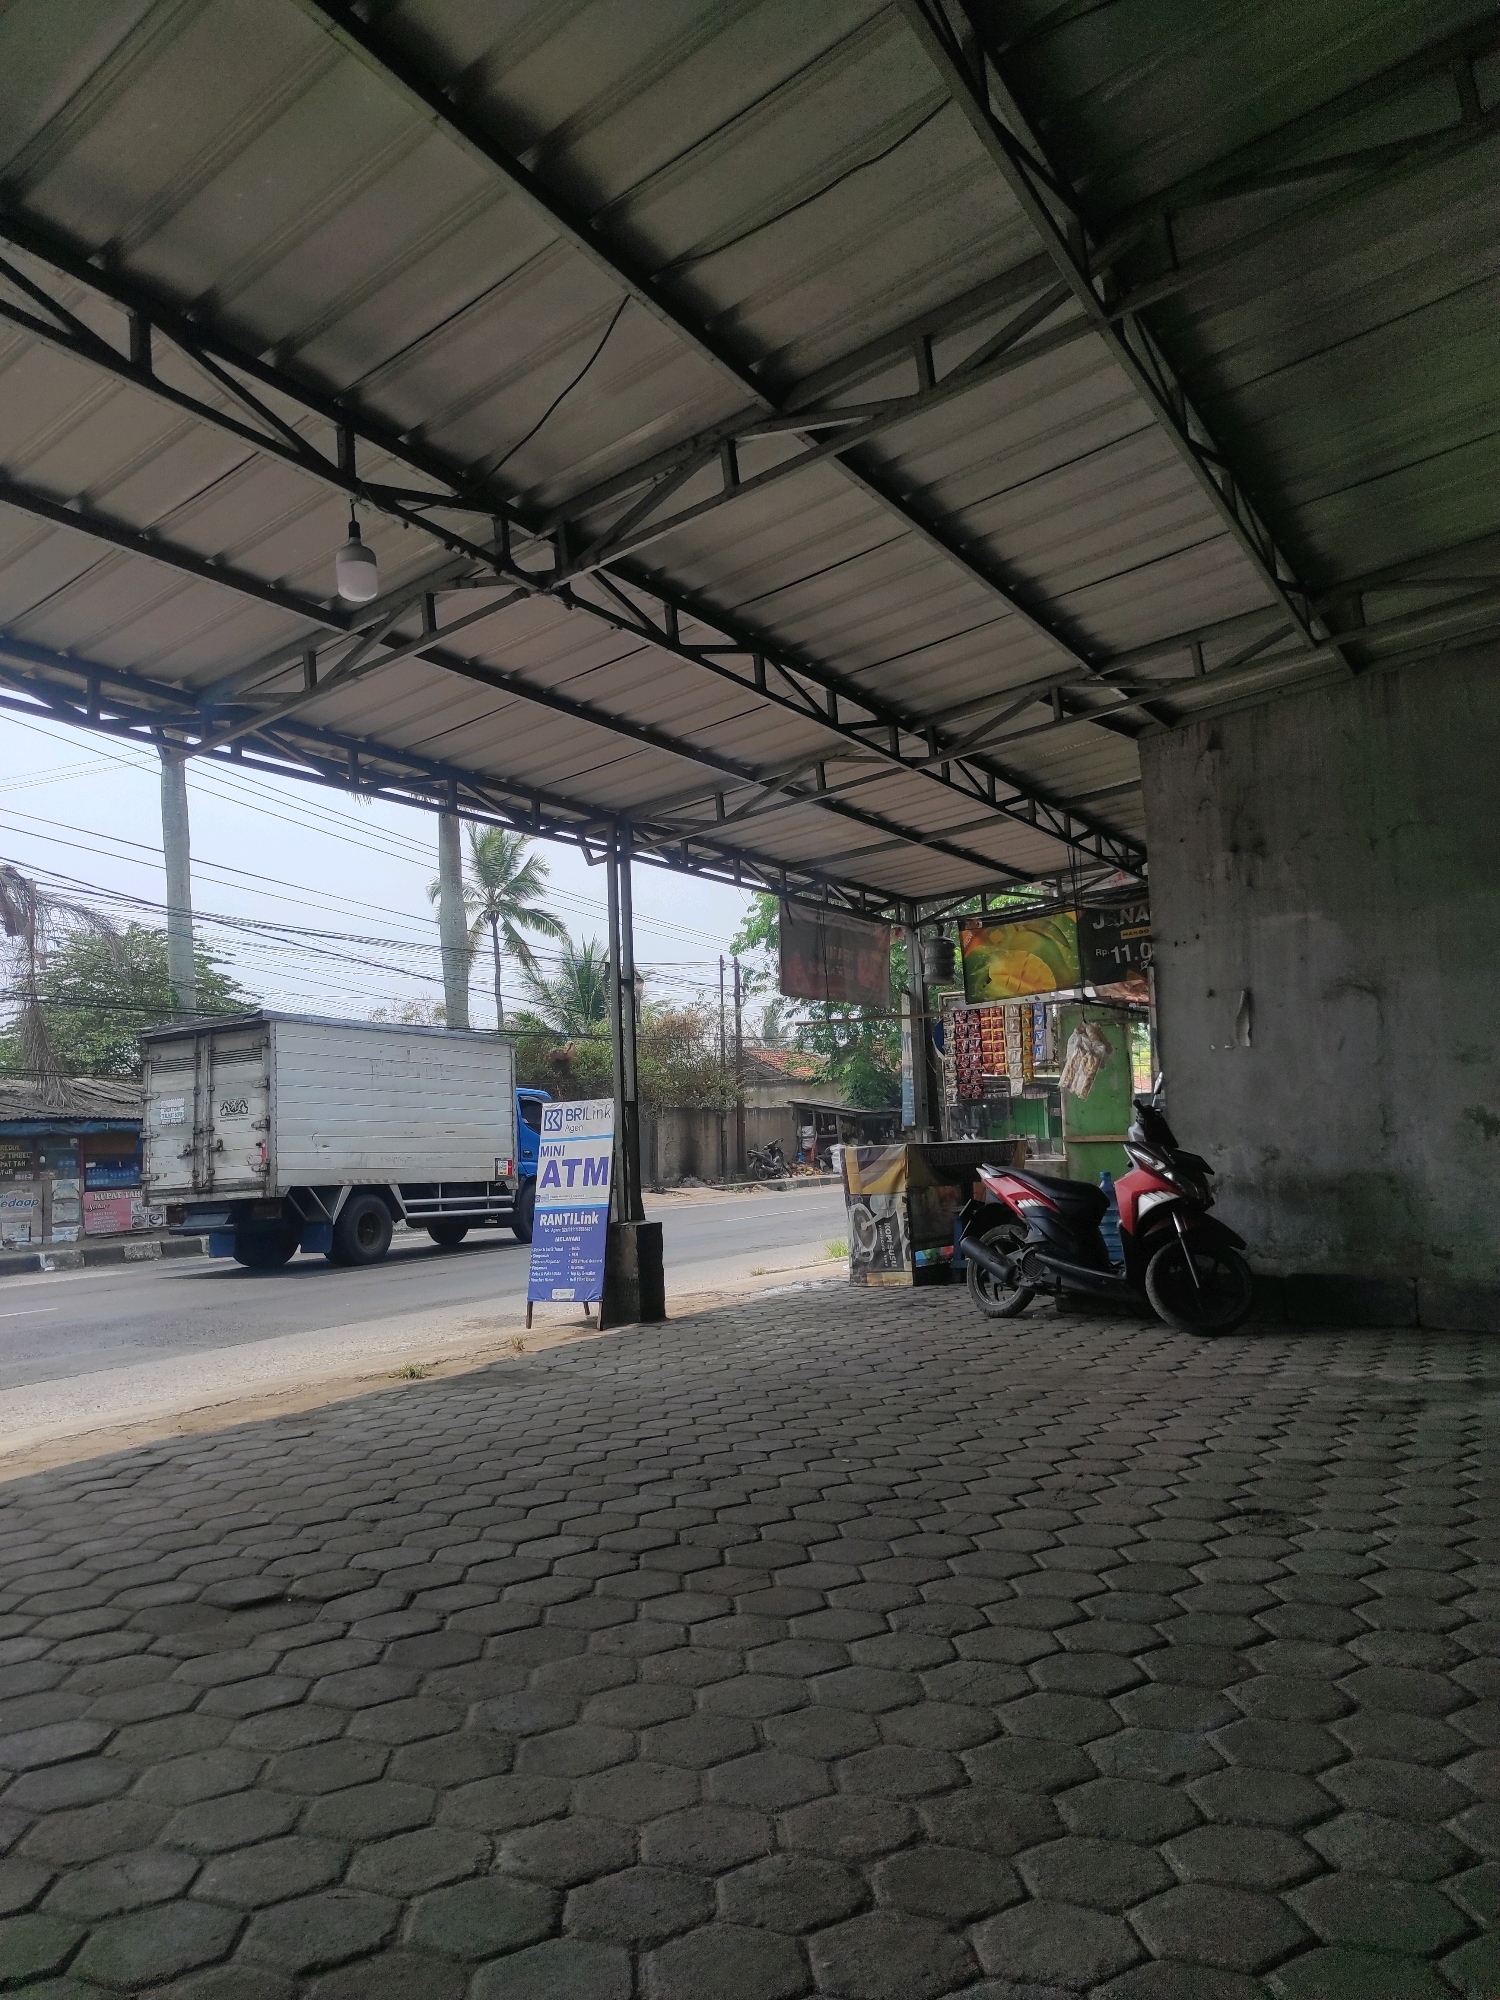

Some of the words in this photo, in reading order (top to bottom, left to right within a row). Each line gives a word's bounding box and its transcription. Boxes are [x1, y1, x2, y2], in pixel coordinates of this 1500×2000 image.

[1122, 928, 1150, 937] MANGO
[565, 1104, 612, 1122] BRILink
[564, 1124, 583, 1134] Agen
[540, 1145, 565, 1158] MINI
[539, 1156, 609, 1189] ATM
[94, 1191, 122, 1201] KUPAT
[540, 1211, 599, 1227] RANTILink
[884, 1222, 893, 1243] KOPI
[887, 1244, 898, 1268] SUSU
